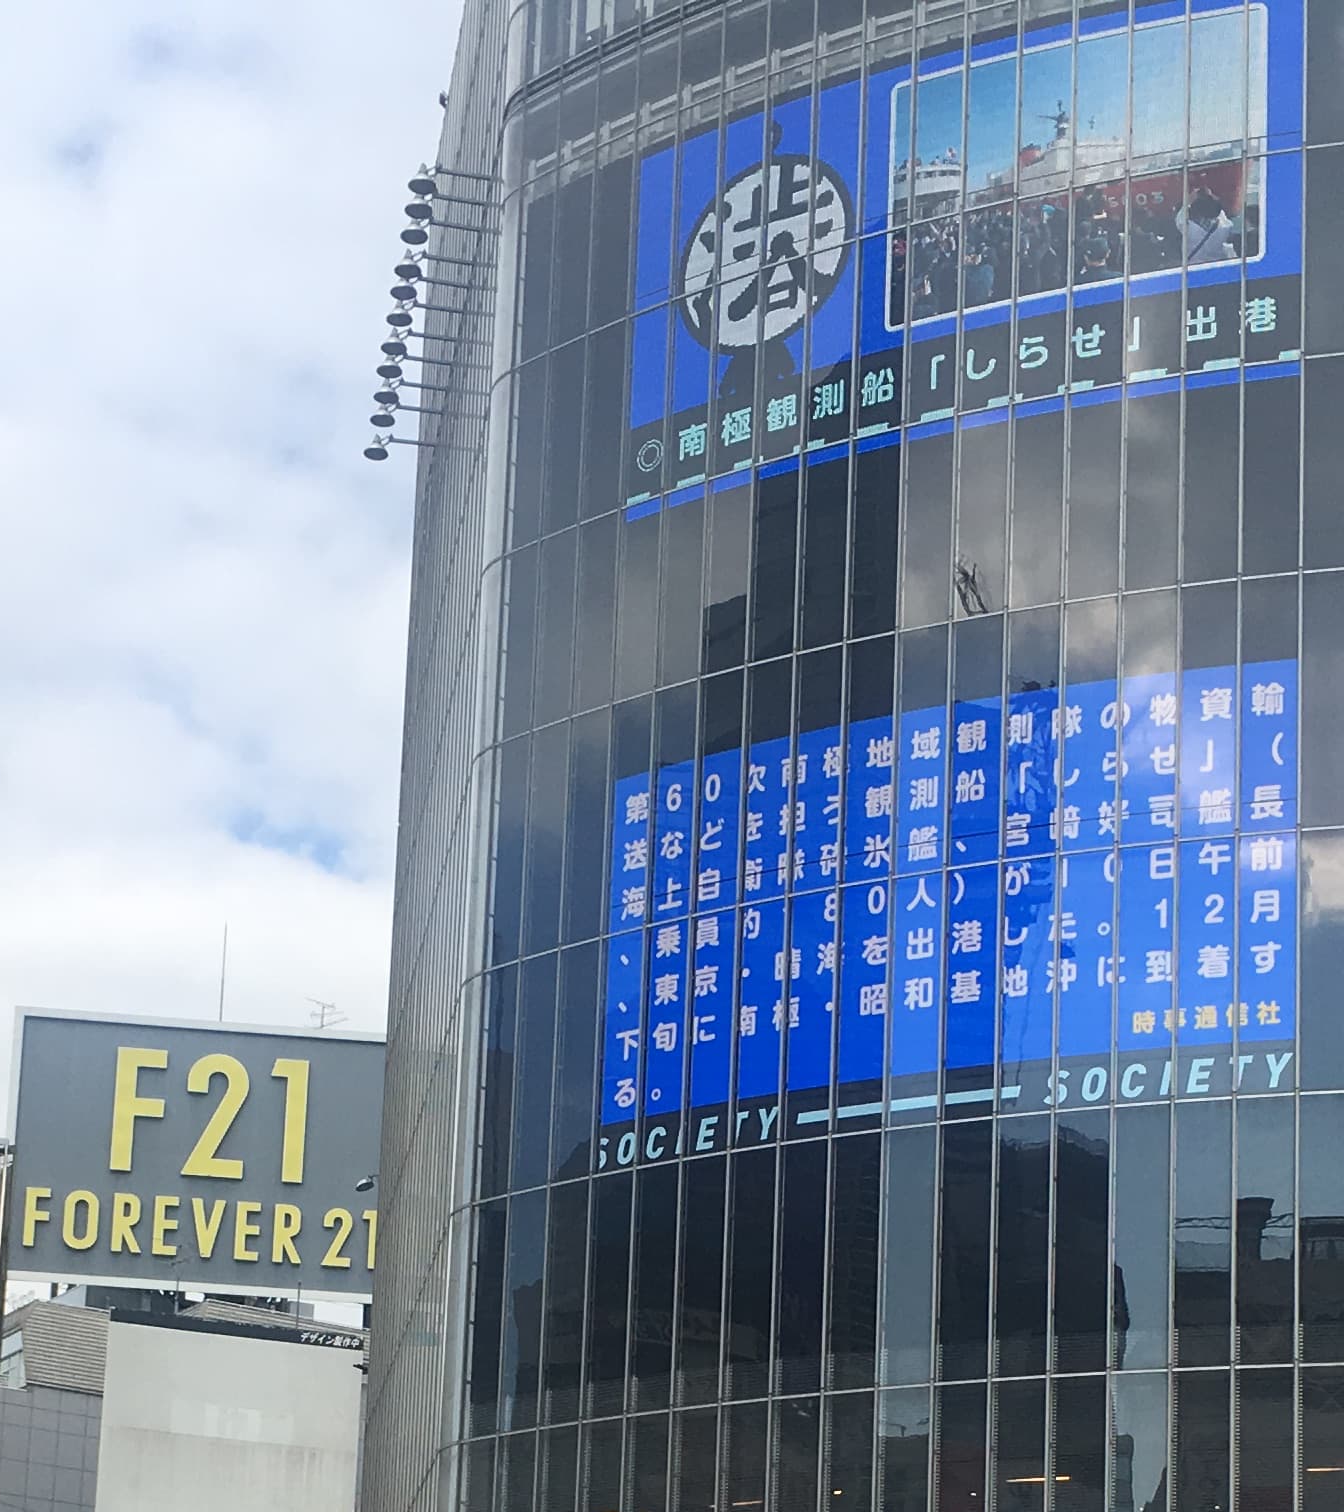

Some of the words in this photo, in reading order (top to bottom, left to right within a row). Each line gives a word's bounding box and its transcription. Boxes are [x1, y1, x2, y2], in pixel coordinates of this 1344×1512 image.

[110, 1047, 310, 1184] F21
[1043, 1052, 1292, 1105] SOCIETY
[22, 1187, 302, 1265] FOREVER
[320, 1208, 376, 1269] 21
